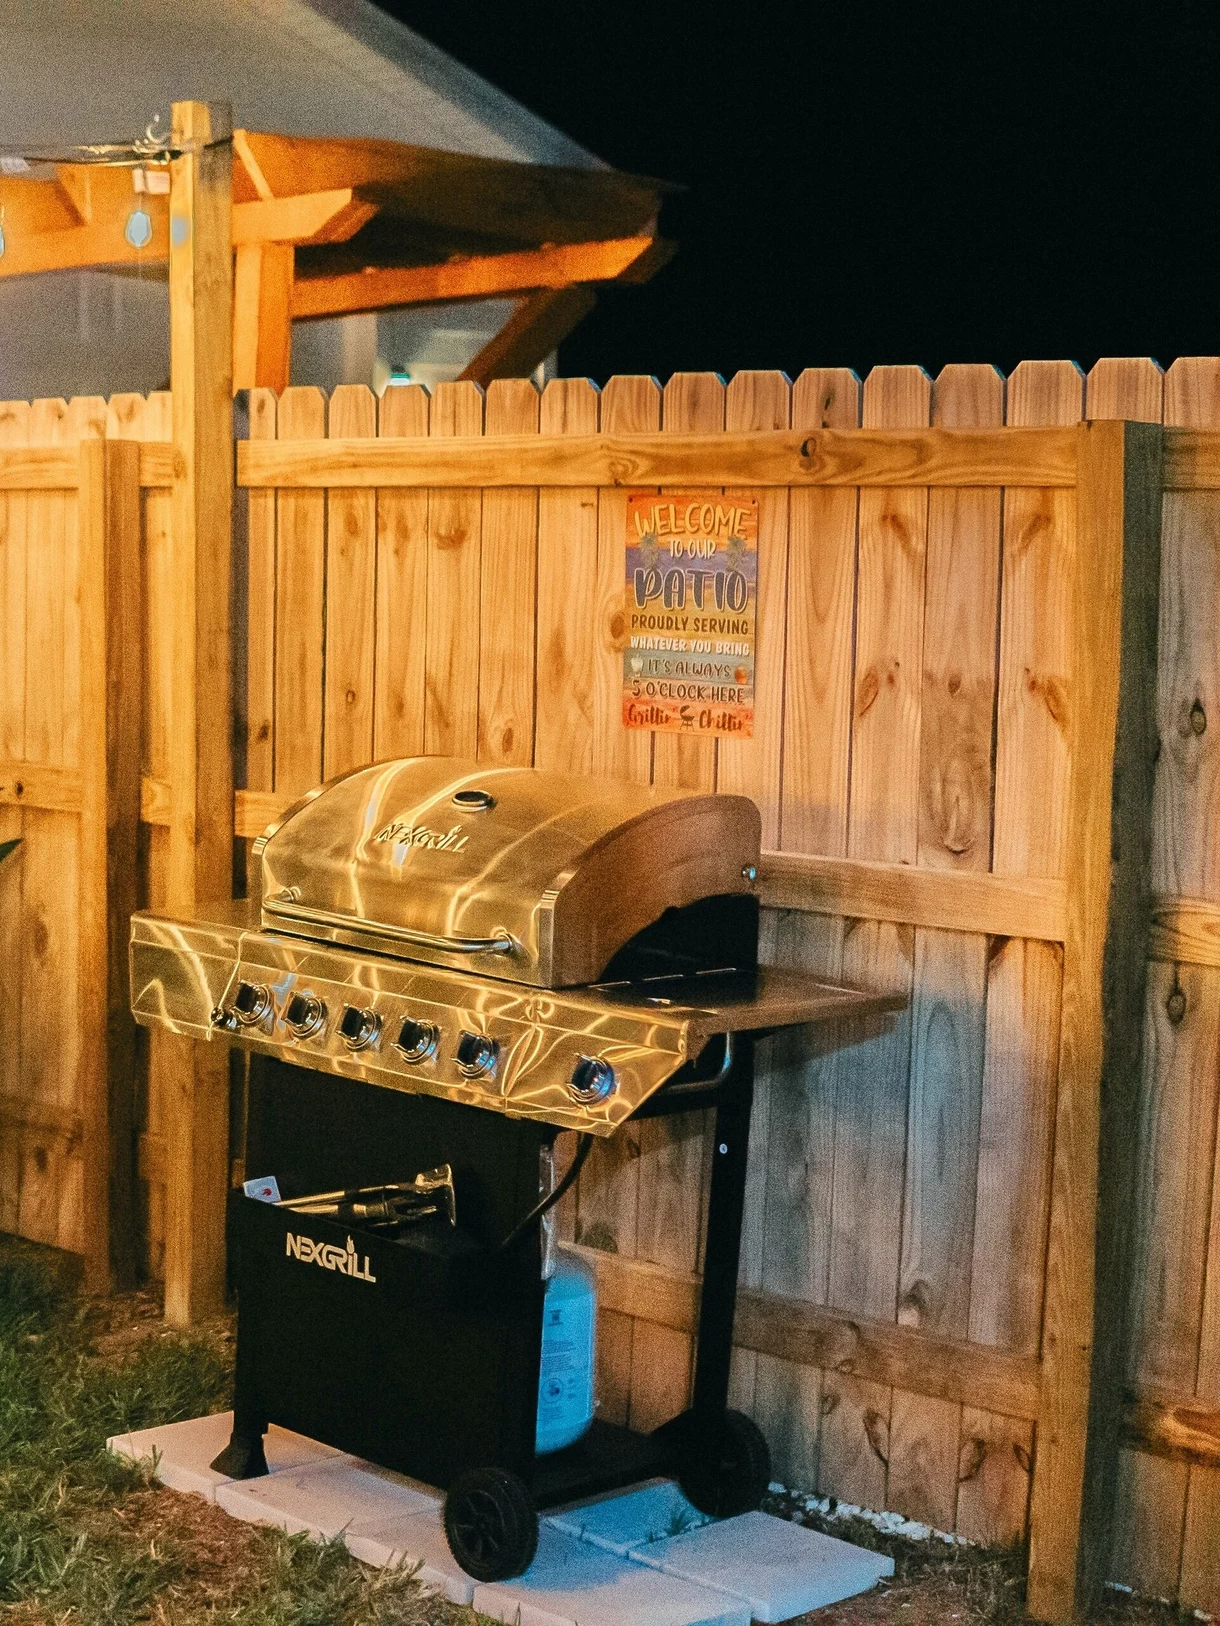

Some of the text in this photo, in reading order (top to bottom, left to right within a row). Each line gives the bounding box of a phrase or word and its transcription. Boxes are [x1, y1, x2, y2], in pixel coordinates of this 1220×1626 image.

[634, 503, 751, 539] WELCOME
[669, 538, 716, 560] TO OUR
[633, 567, 749, 614] PATIO
[631, 614, 749, 635] PROUDLY SERVING
[630, 635, 750, 656] WHATEVER YOU BRING
[648, 659, 731, 677] IT'S ALWAYS
[632, 680, 745, 703] 5 O'CLOCK HERE
[286, 1232, 376, 1283] NEXGRILL
